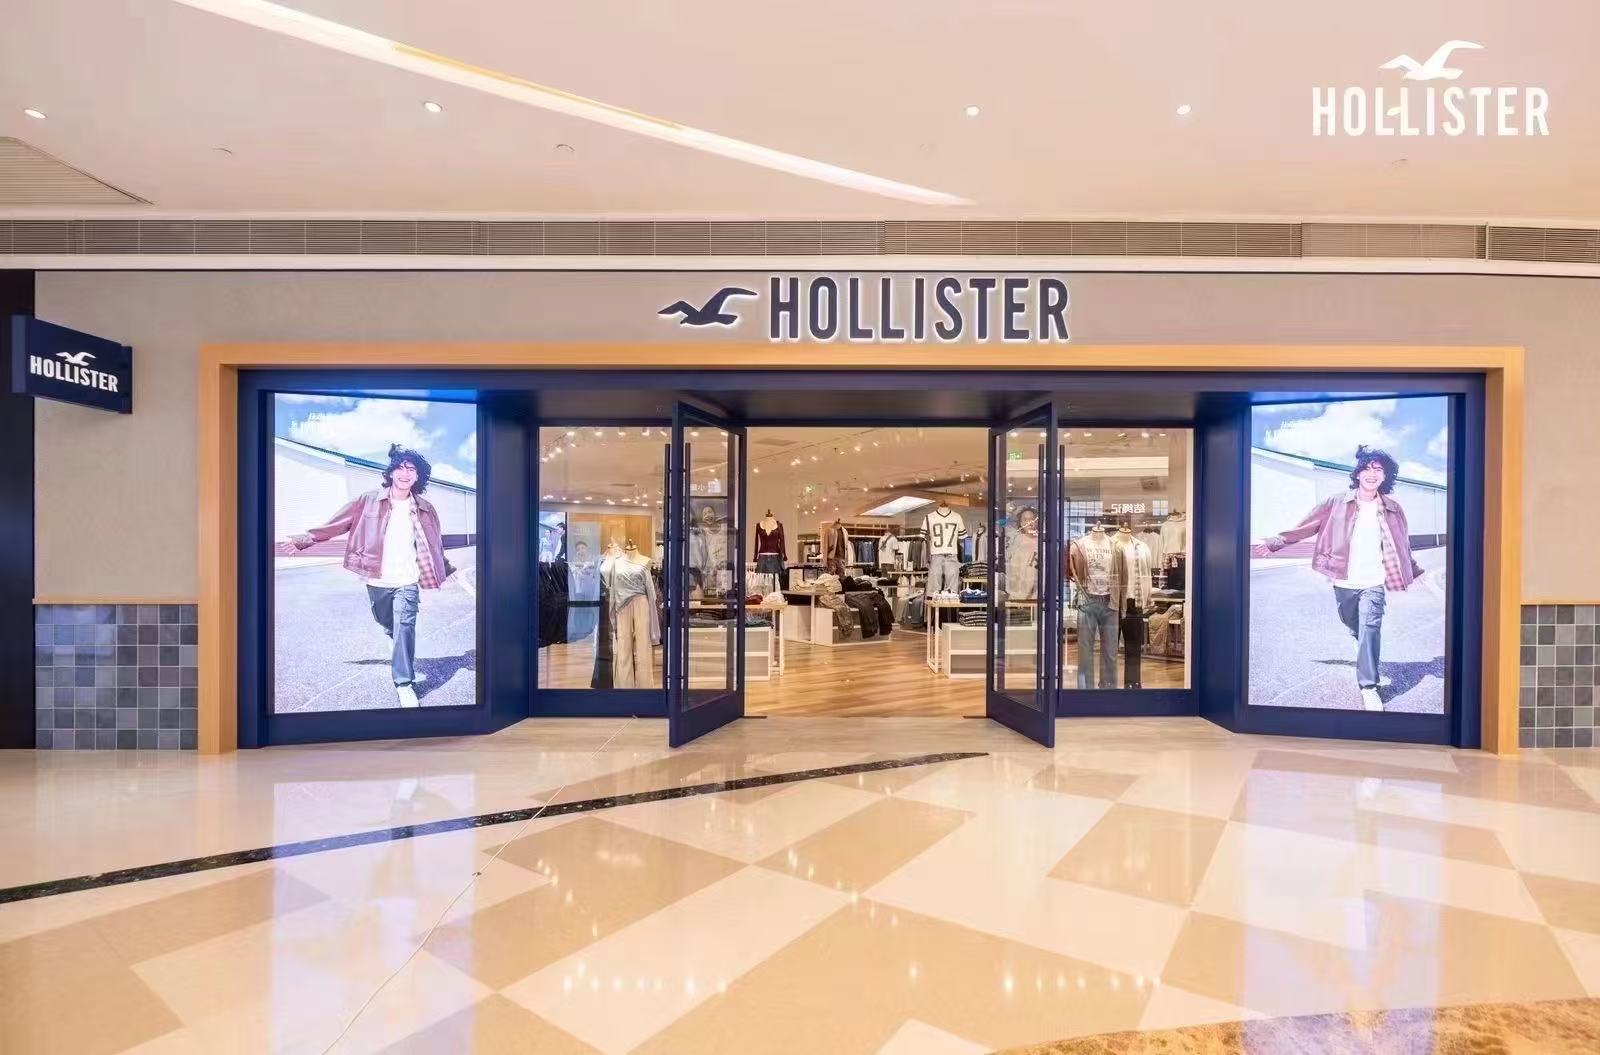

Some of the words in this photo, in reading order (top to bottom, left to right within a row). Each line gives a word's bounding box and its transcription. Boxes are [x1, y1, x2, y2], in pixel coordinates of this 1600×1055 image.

[770, 276, 1069, 340] HOLLISTER
[30, 355, 118, 393] HOLLISTER
[933, 522, 957, 547] 97
